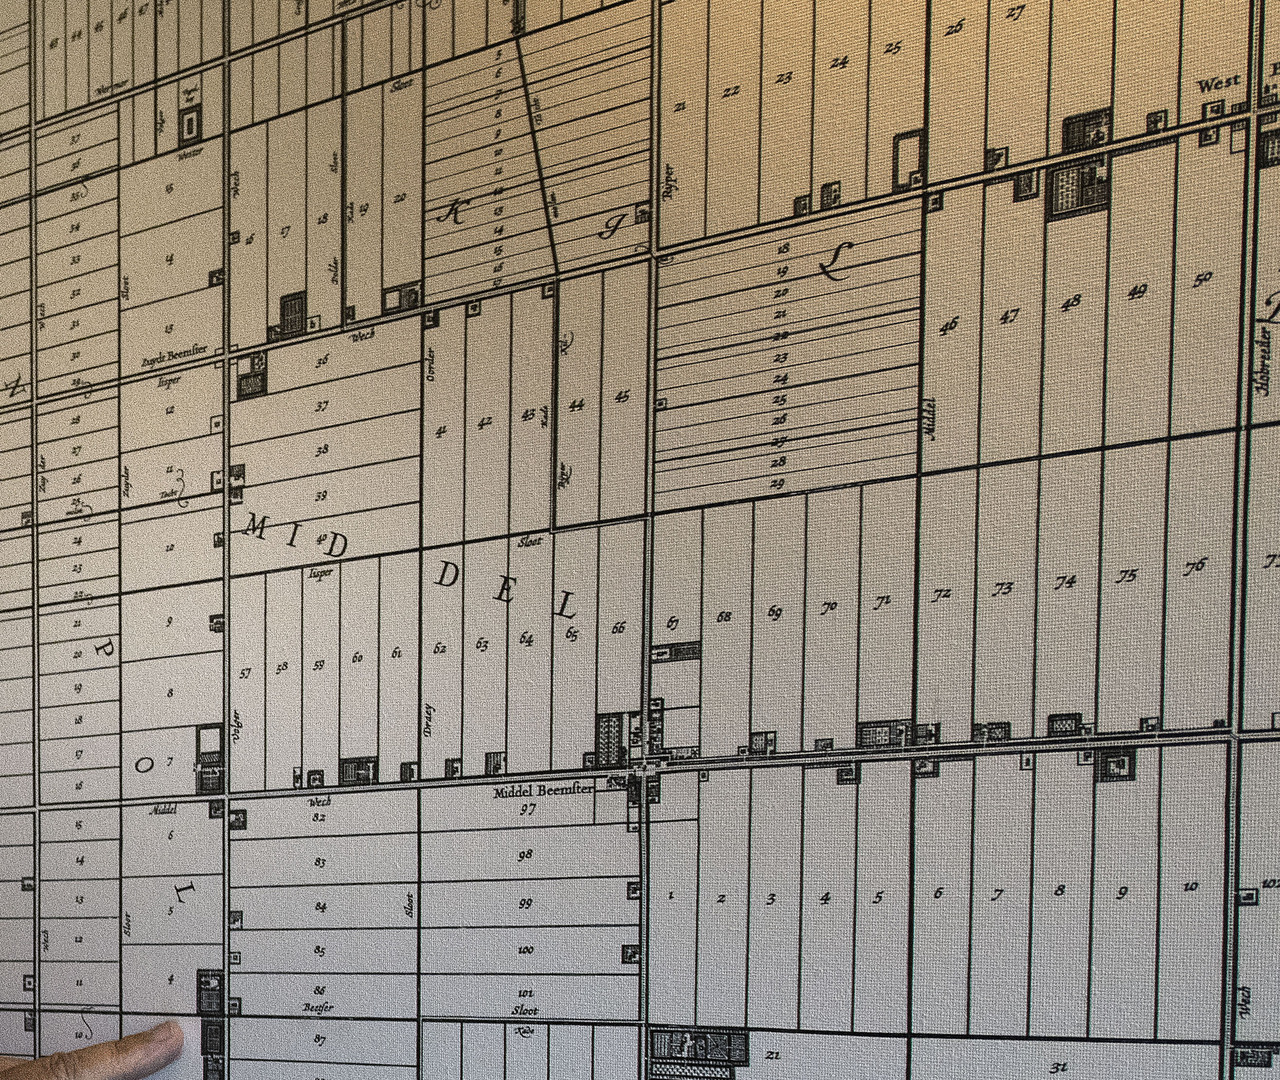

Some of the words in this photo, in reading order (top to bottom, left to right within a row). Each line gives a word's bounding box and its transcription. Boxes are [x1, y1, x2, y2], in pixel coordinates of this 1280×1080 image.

[1007, 5, 1026, 20] 27
[944, 19, 964, 36] 26
[831, 55, 850, 69] 24
[1196, 73, 1240, 94] West
[722, 85, 740, 98] 22
[359, 202, 369, 216] 19
[1192, 271, 1212, 288] 50
[1062, 294, 1082, 312] 48
[939, 317, 959, 336] 46
[316, 354, 330, 368] 36
[615, 389, 629, 403] 45
[521, 408, 535, 421] 43
[477, 416, 492, 430] 42
[436, 425, 447, 438] 41
[1183, 557, 1208, 576] 76
[1055, 574, 1076, 590] 74
[992, 581, 1013, 597] 73
[820, 601, 837, 615] 70
[873, 595, 890, 610] 71
[716, 611, 731, 623] 68
[612, 621, 625, 634] 66
[519, 632, 533, 646] 64
[433, 642, 447, 654] 62
[351, 651, 363, 664] 60
[312, 659, 325, 671] 59
[312, 813, 326, 822] 82
[314, 857, 326, 868] 83
[1053, 884, 1065, 897] 8
[1183, 880, 1198, 892] 10
[716, 891, 726, 904] 2
[819, 890, 831, 905] 4
[933, 887, 943, 900] 6
[315, 901, 327, 913] 84
[518, 897, 532, 910] 99
[518, 945, 534, 955] 100
[518, 988, 534, 998] 101
[765, 1049, 781, 1060] 21
